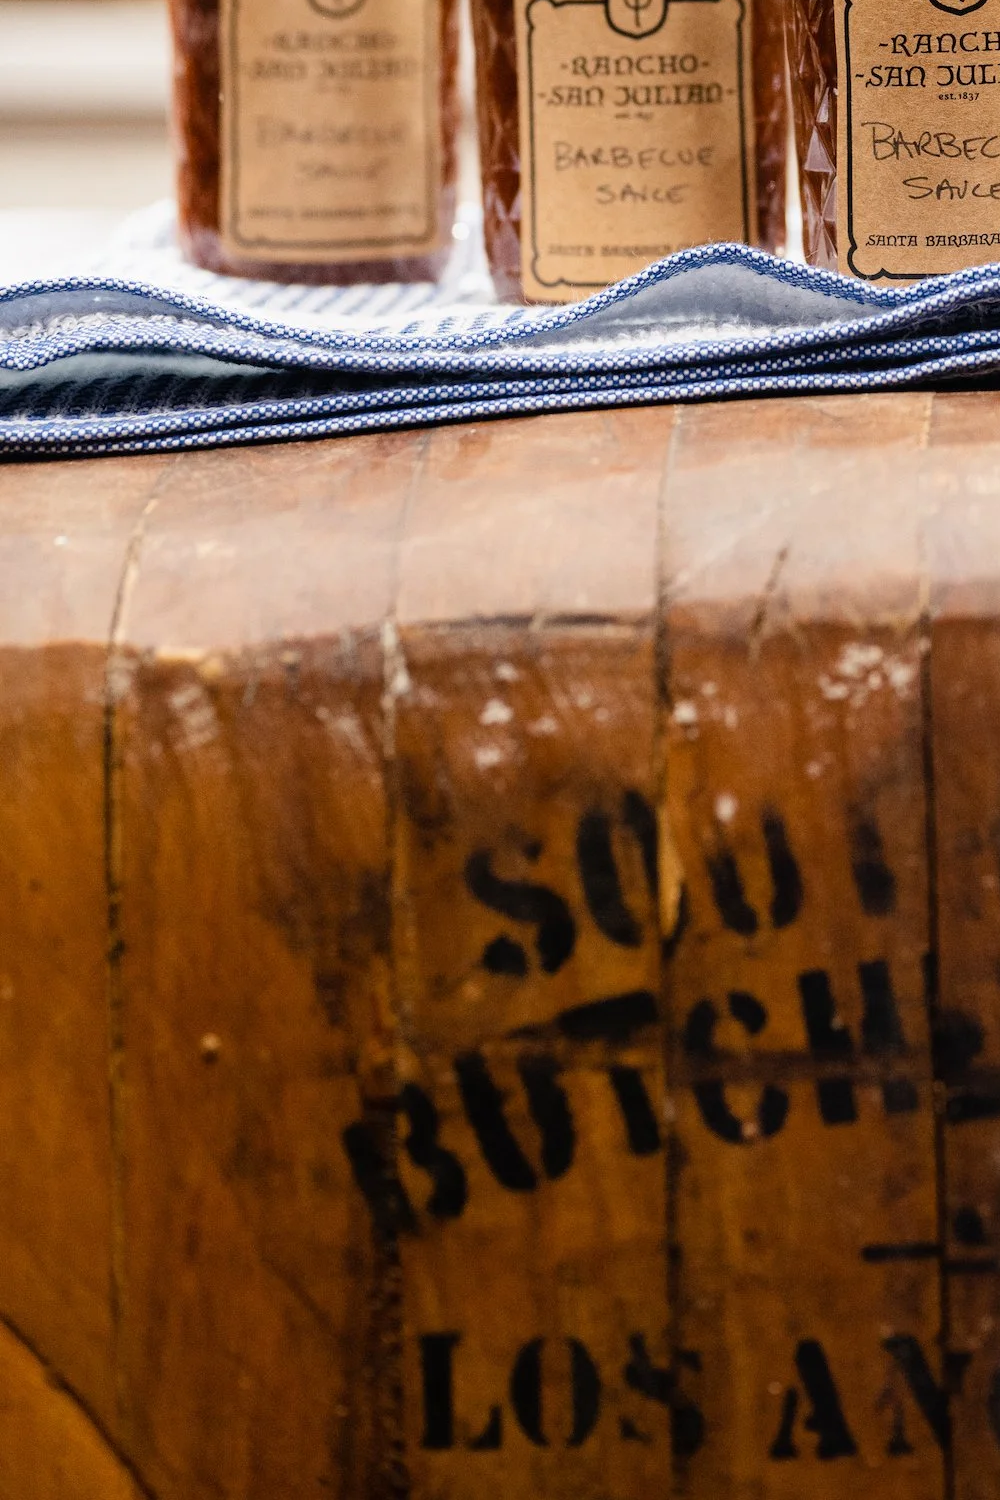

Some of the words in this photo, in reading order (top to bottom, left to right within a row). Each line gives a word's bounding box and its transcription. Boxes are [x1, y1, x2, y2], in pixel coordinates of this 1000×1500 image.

[958, 91, 980, 102] 1837
[553, 140, 716, 172] BARBECUE
[595, 183, 690, 206] SAUCE
[865, 233, 918, 247] SANTA
[925, 231, 1000, 248] BARBARA
[419, 1330, 706, 1457] LOS
